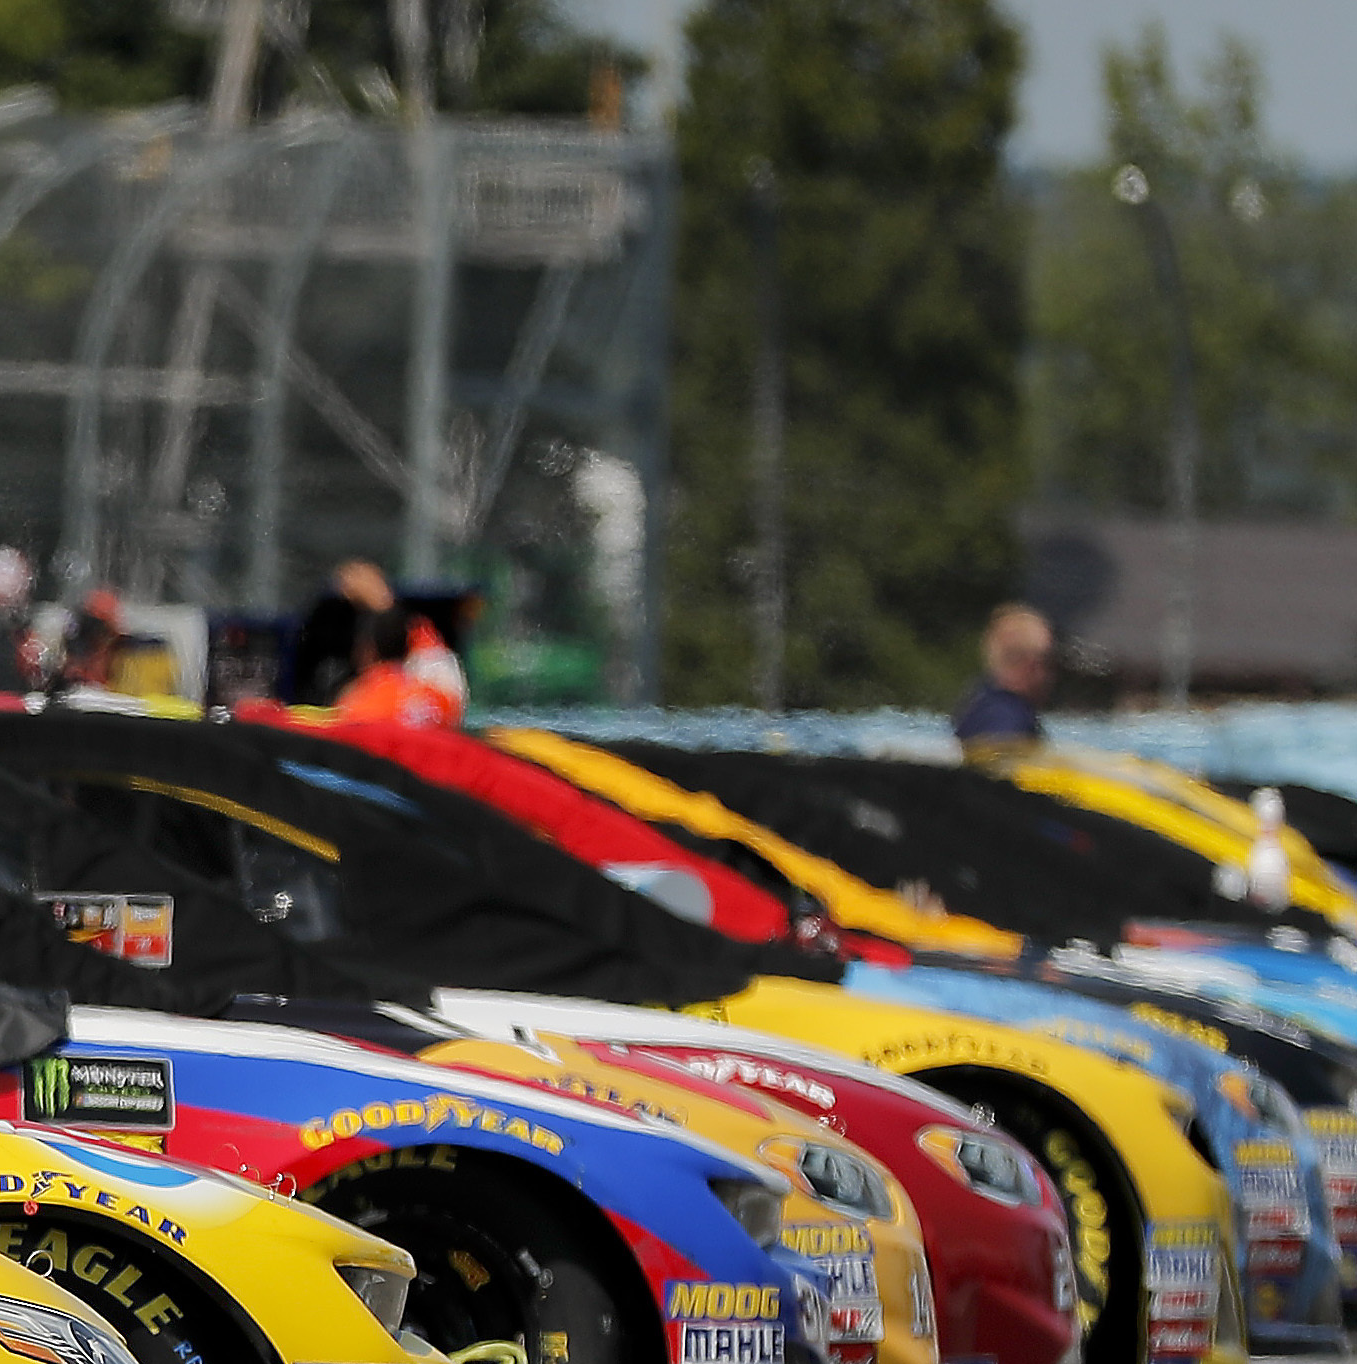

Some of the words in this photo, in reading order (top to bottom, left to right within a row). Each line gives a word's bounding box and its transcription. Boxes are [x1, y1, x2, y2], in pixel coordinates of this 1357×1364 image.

[299, 1093, 565, 1156] GOODYEAR
[671, 1282, 781, 1321] MOOG
[686, 1325, 783, 1364] MAHLE
